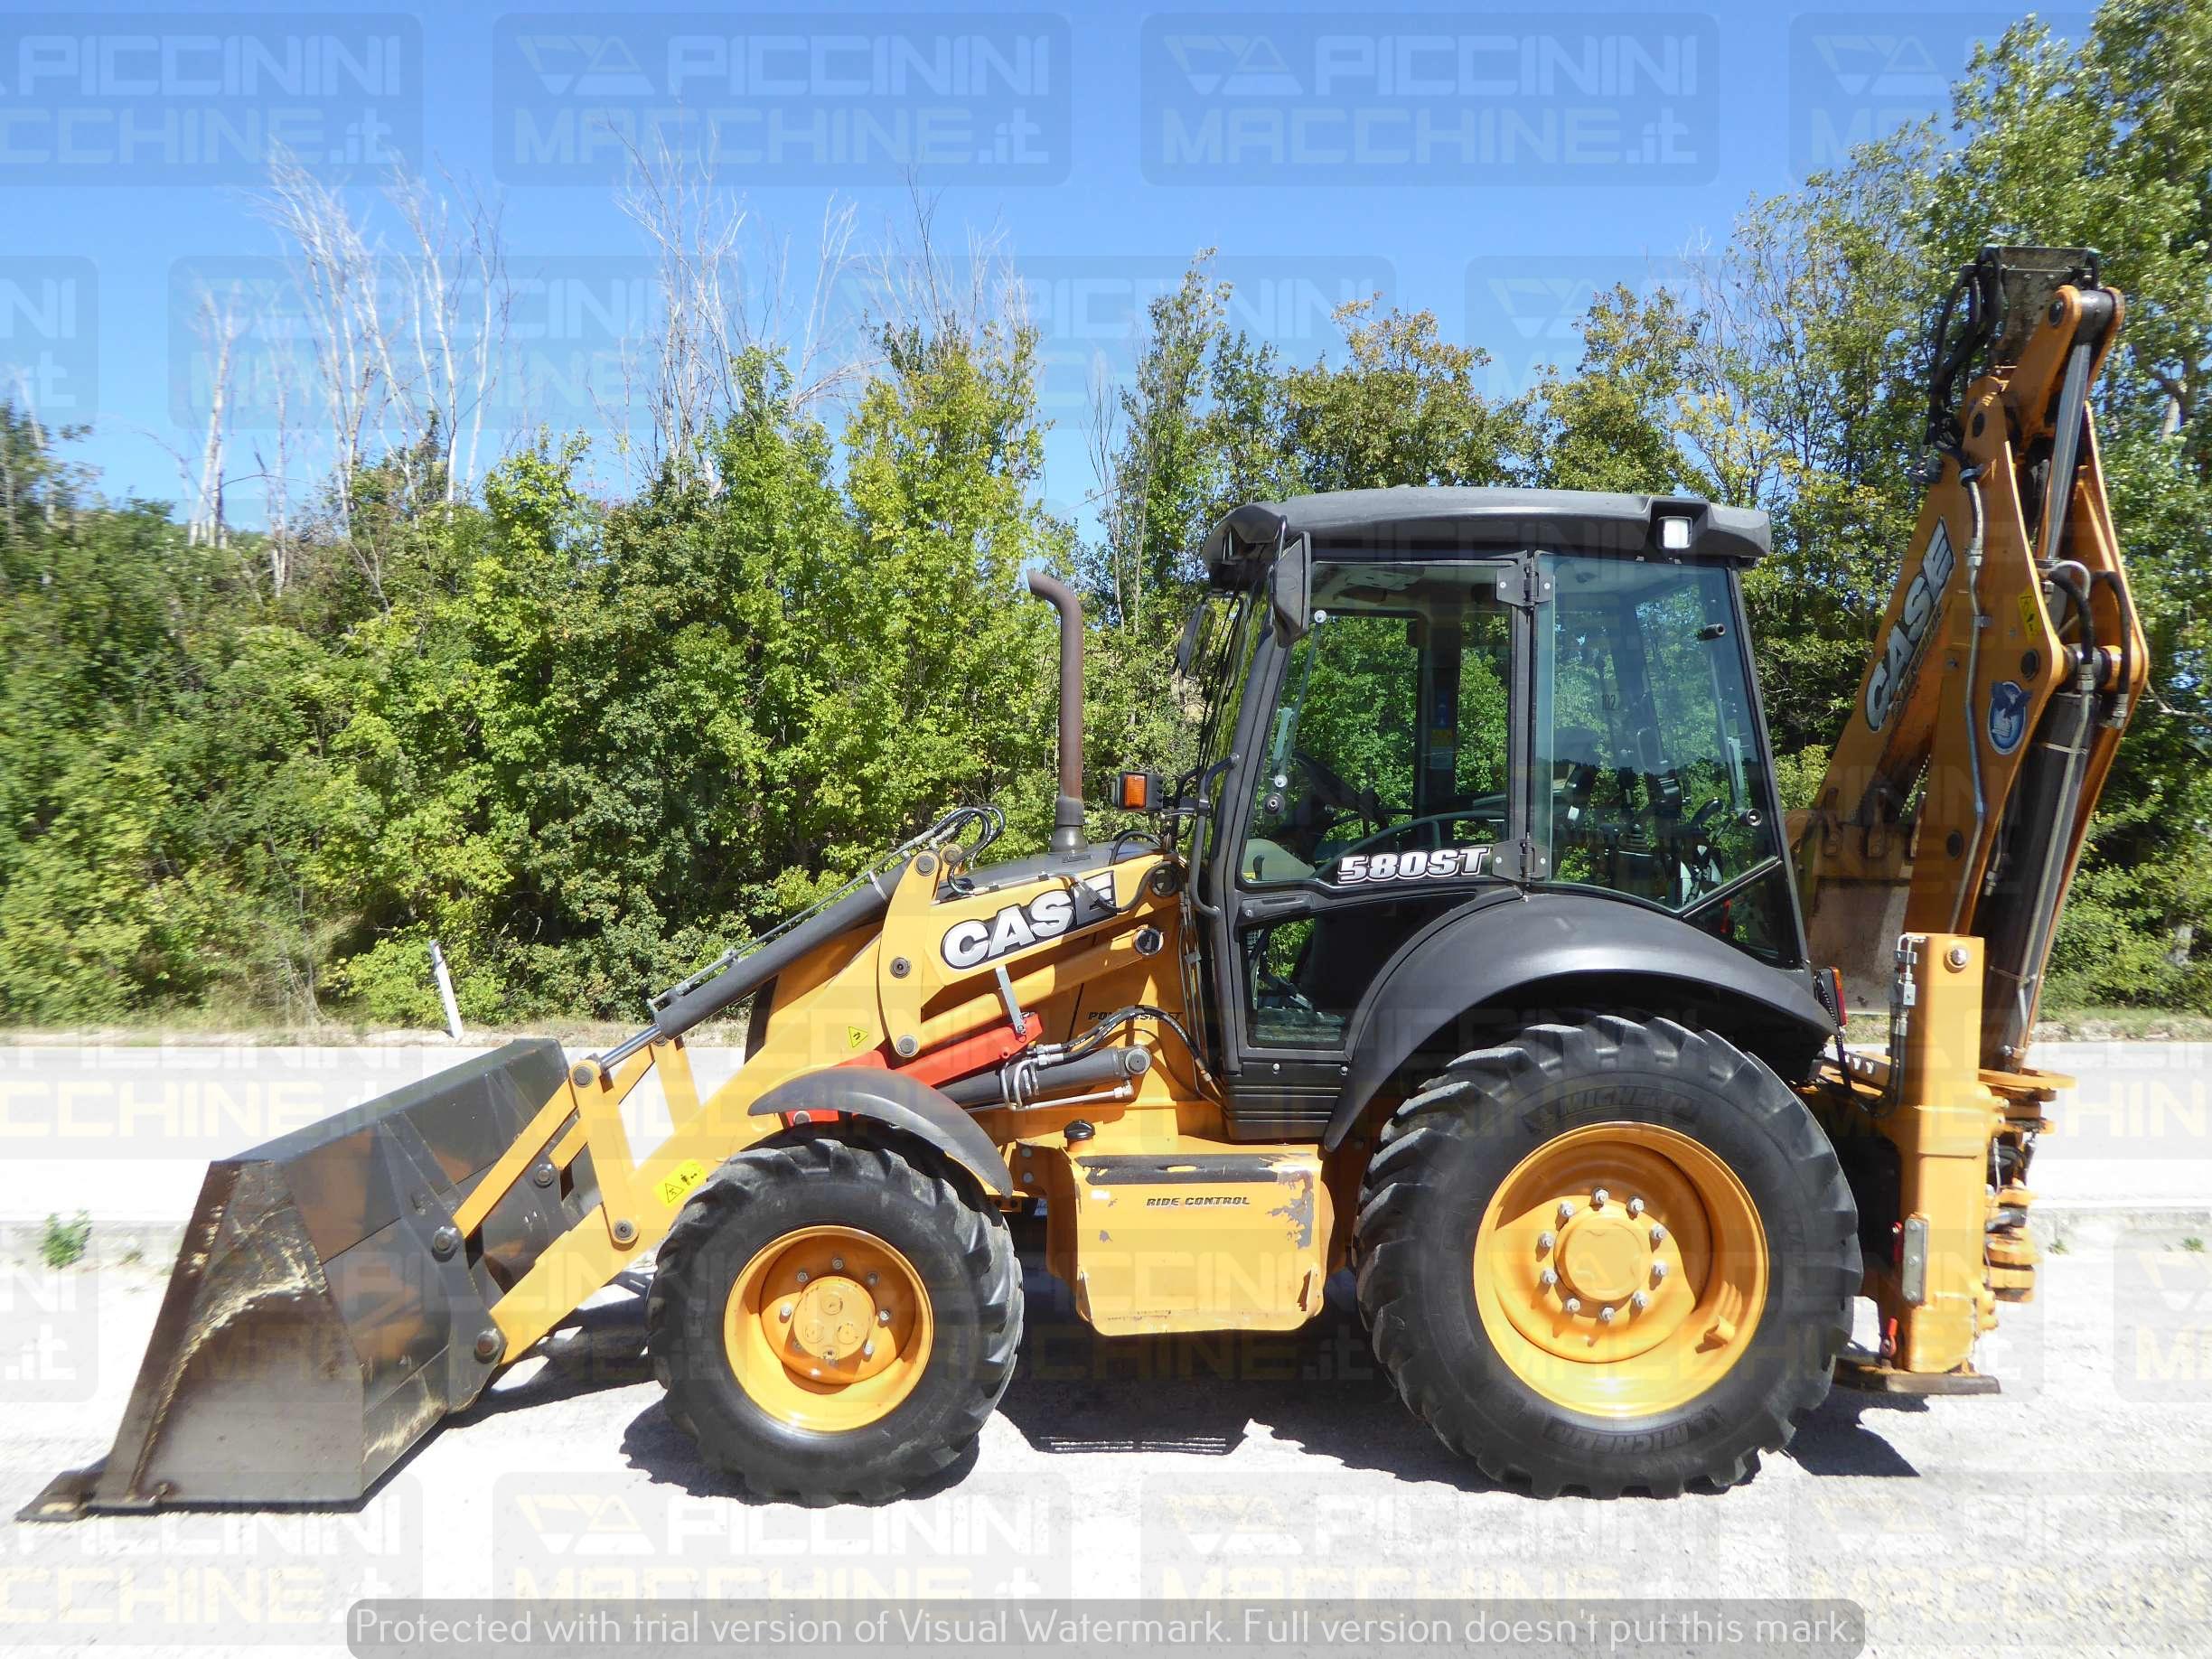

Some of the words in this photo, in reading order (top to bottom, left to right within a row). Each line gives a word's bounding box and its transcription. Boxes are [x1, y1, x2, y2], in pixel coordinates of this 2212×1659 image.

[1866, 517, 1955, 734] CASE
[1337, 847, 1491, 885] 580ST
[941, 870, 1116, 970] CASE
[1146, 1197, 1181, 1206] RIDE
[1185, 1196, 1251, 1205] CONTROL
